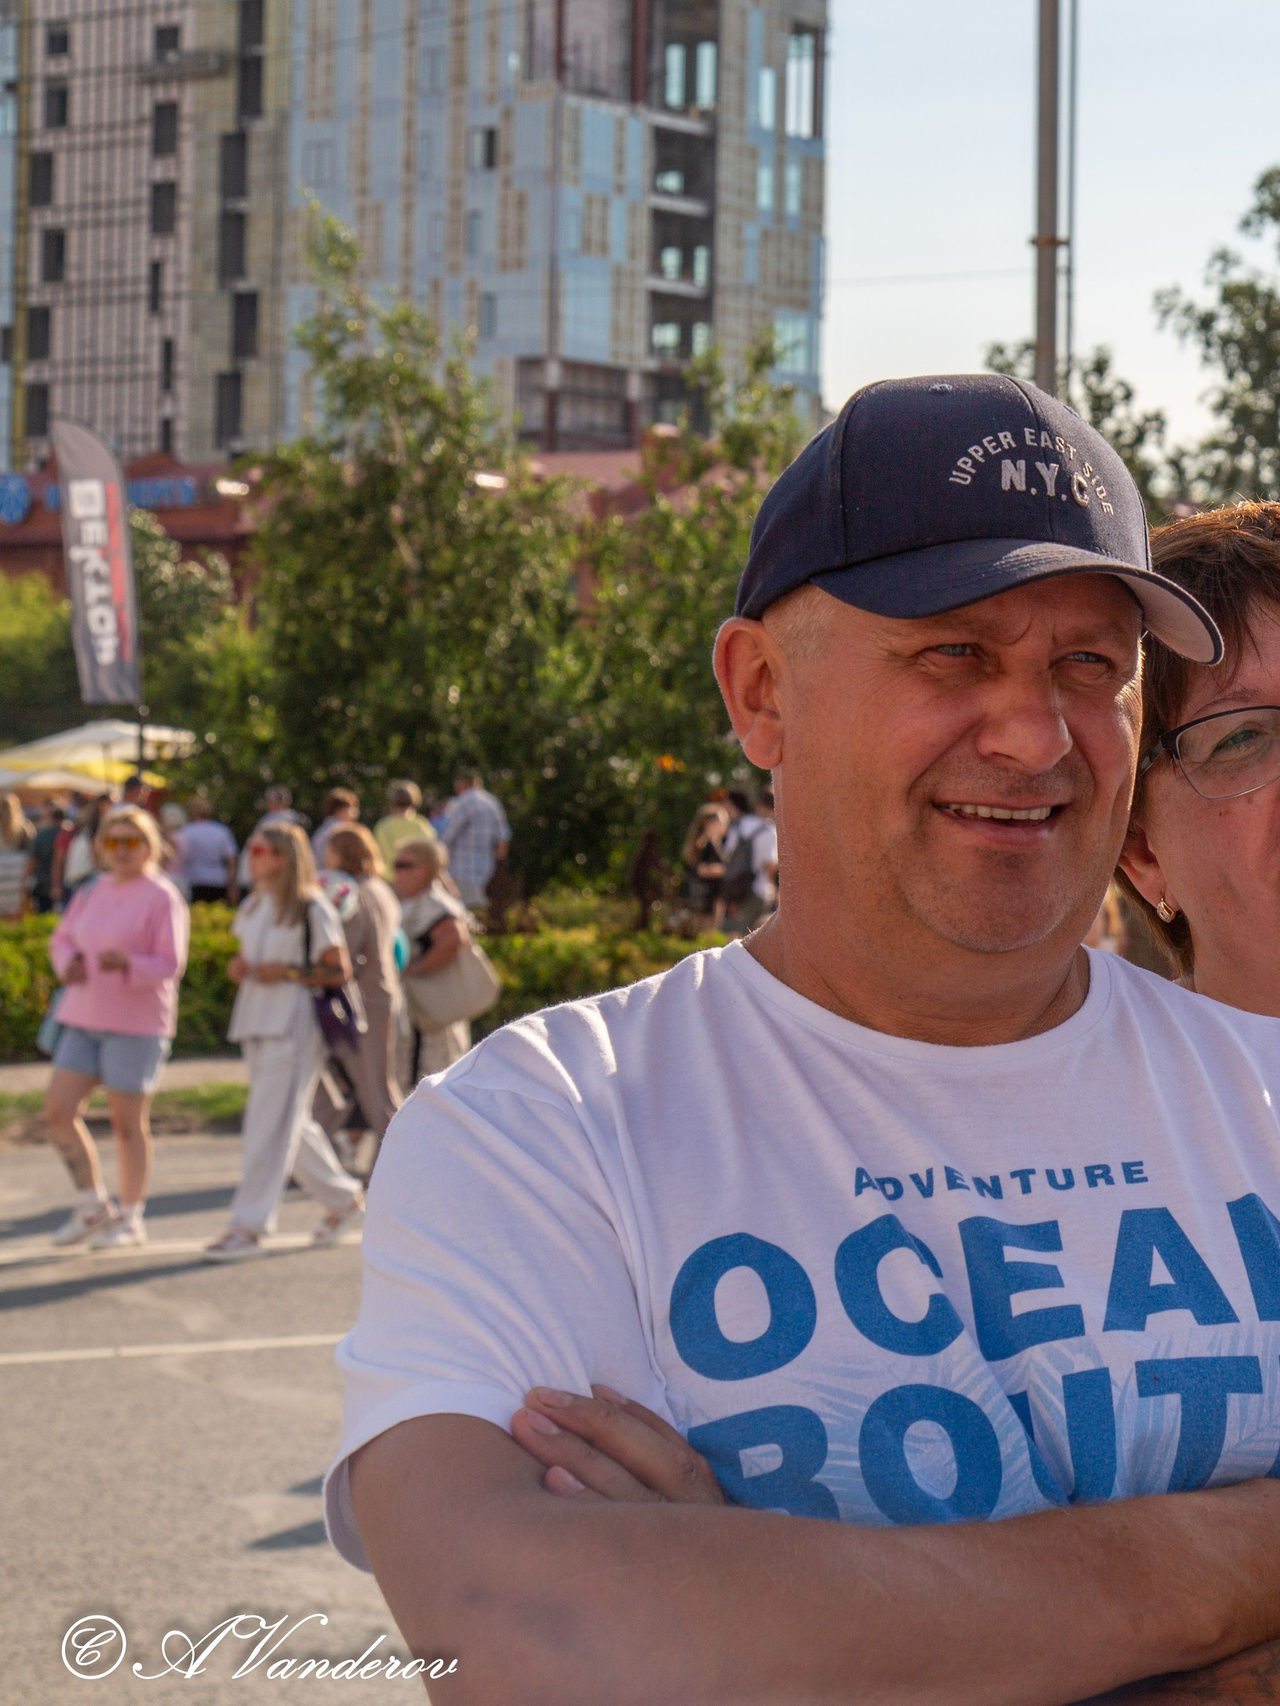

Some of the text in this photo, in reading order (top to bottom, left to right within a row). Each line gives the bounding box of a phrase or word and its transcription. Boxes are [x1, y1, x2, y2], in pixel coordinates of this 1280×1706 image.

[949, 427, 1114, 516] UPPER EAST SIDE
[854, 1160, 1149, 1201] ADVENTURE
